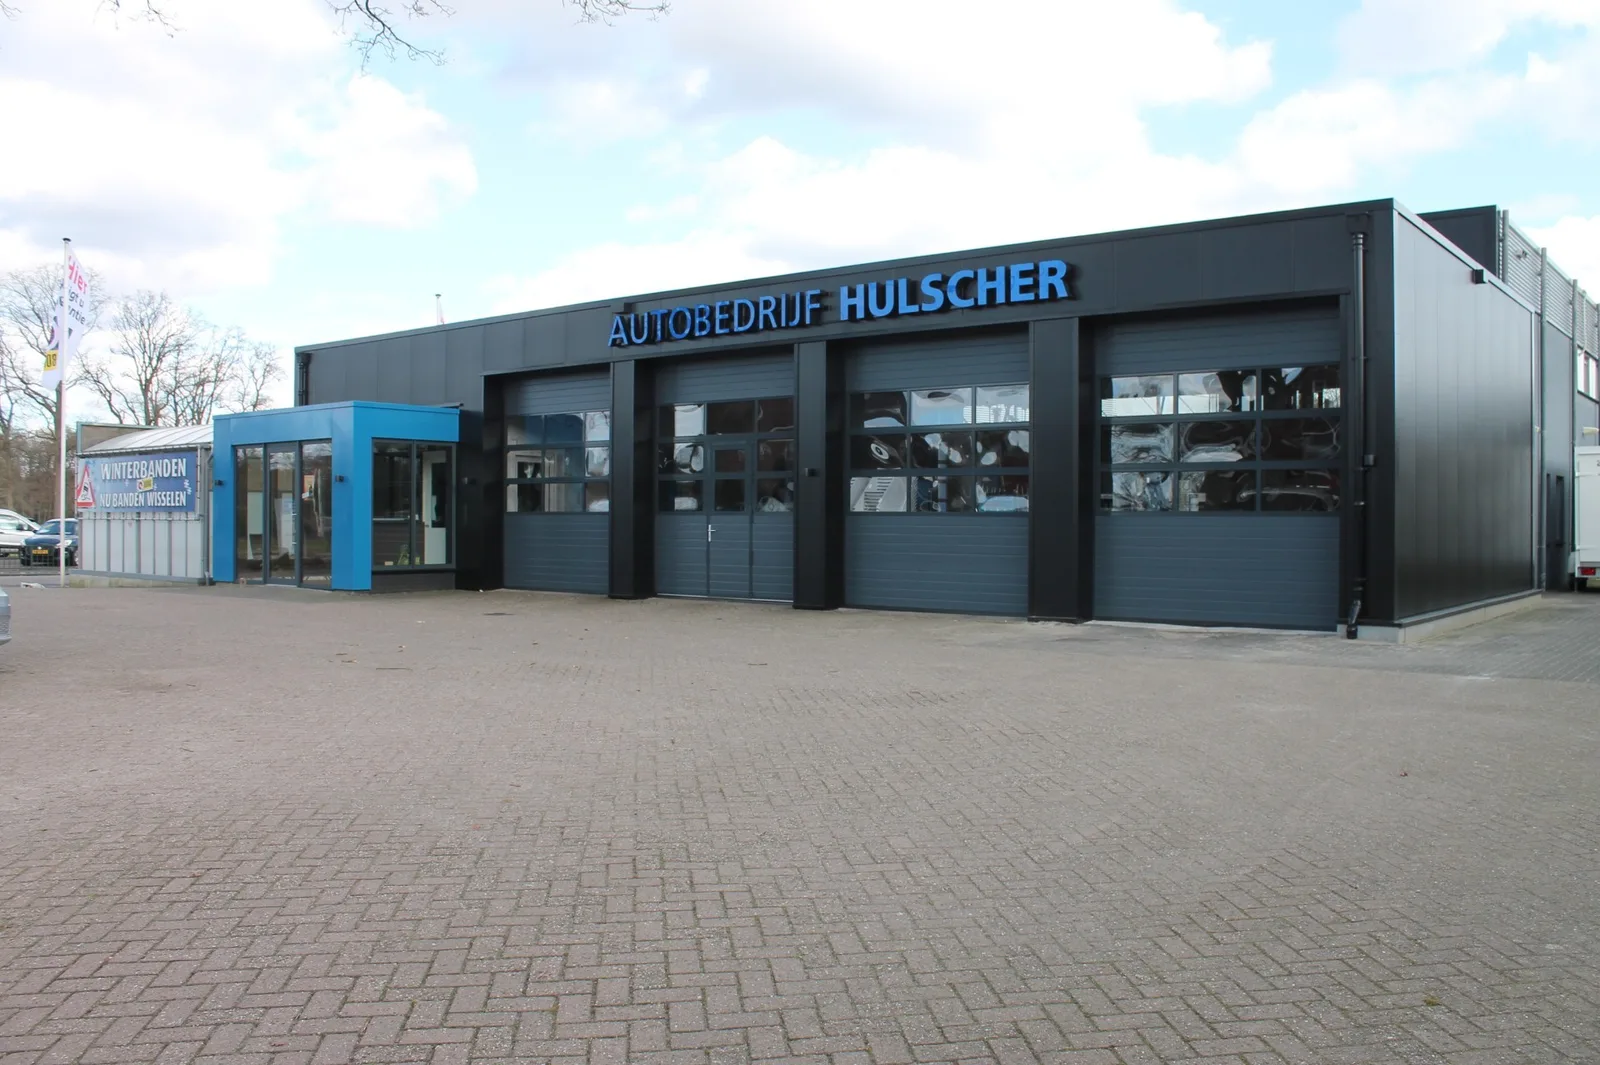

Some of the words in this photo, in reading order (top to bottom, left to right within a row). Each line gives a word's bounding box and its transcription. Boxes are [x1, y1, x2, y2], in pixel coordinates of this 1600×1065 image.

[607, 289, 821, 347] AUTOBEDRIJF
[839, 259, 1069, 321] HULSCHER
[101, 458, 187, 480] WINTERBANDEN
[100, 493, 111, 507] NU
[112, 492, 145, 508] BANDEN
[147, 491, 187, 507] WISSELEN
